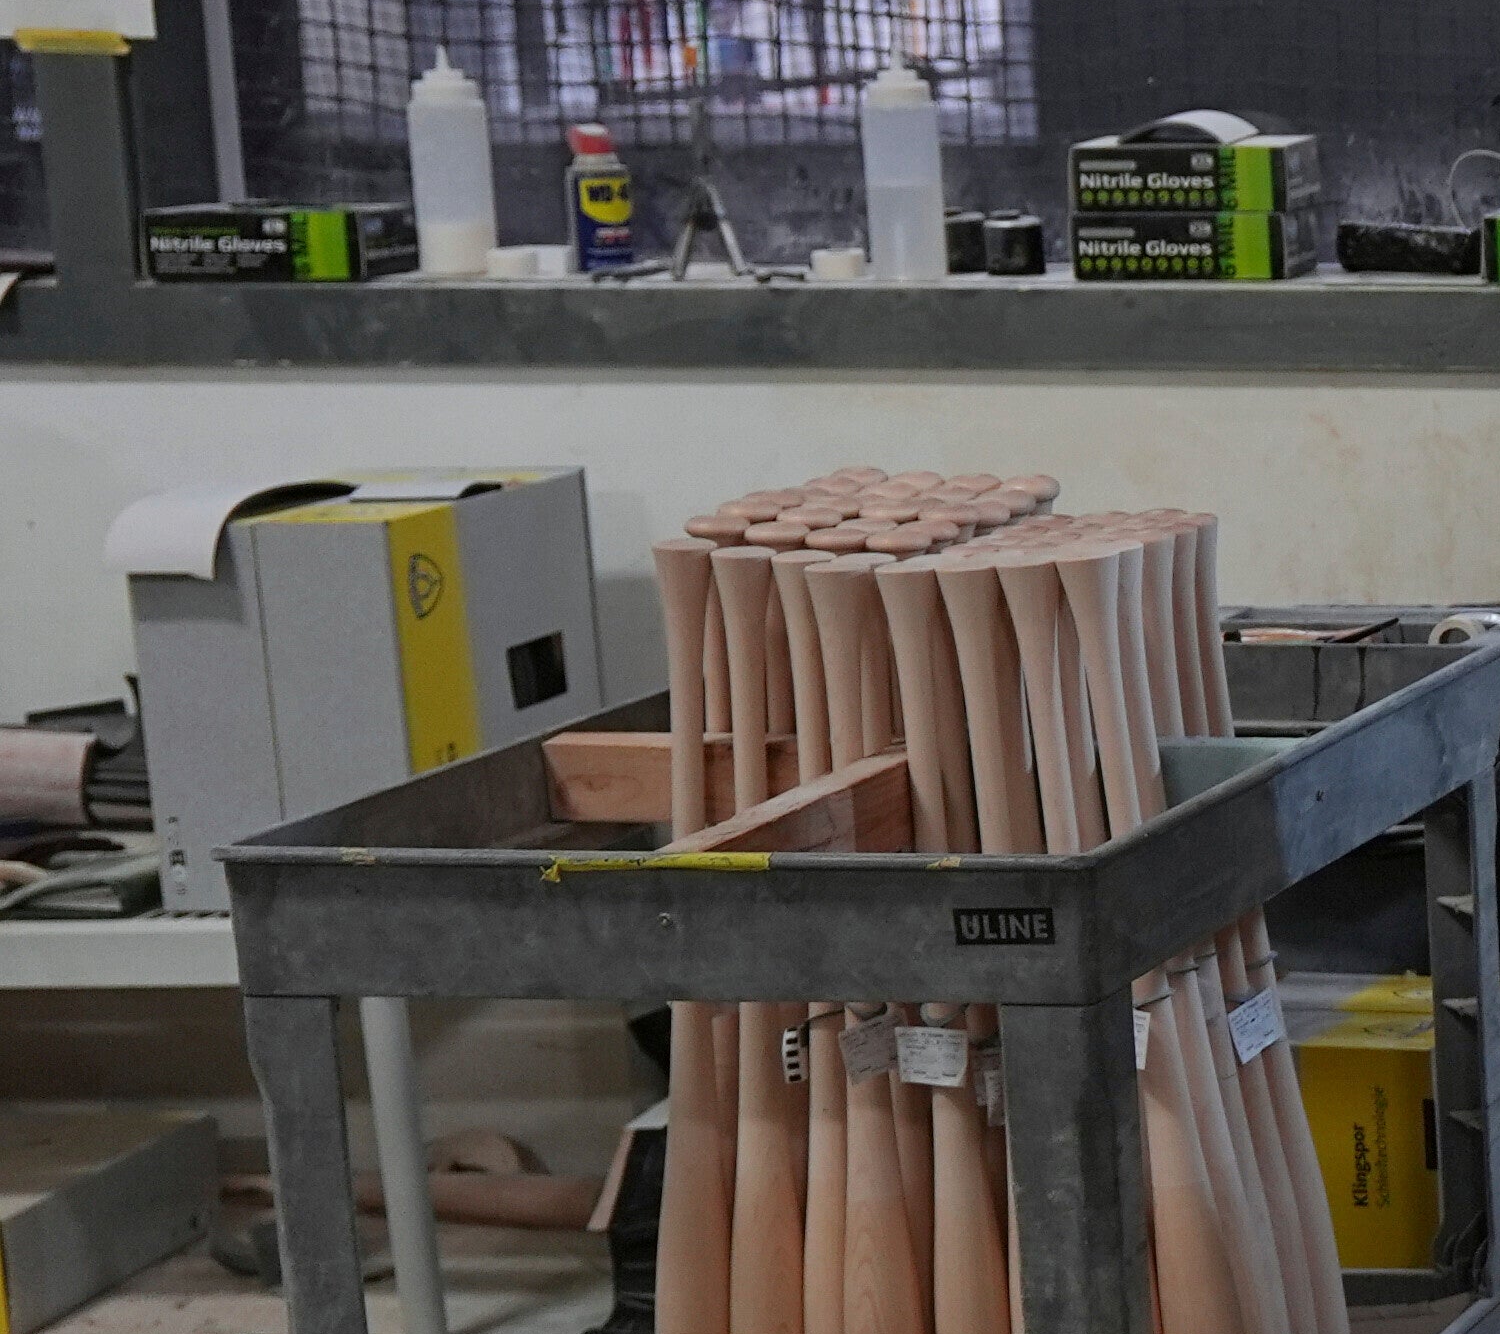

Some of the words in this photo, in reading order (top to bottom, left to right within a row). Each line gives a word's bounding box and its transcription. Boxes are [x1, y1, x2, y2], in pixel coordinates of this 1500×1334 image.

[1079, 172, 1144, 189] Nitrile
[1146, 172, 1215, 189] Gloves
[587, 182, 629, 202] WD-4
[217, 235, 288, 254] Gloves
[1078, 240, 1142, 257] Nitrile
[1145, 239, 1213, 257] Gloves
[960, 914, 1049, 940] ULINE
[1352, 1121, 1372, 1207] Klingspor
